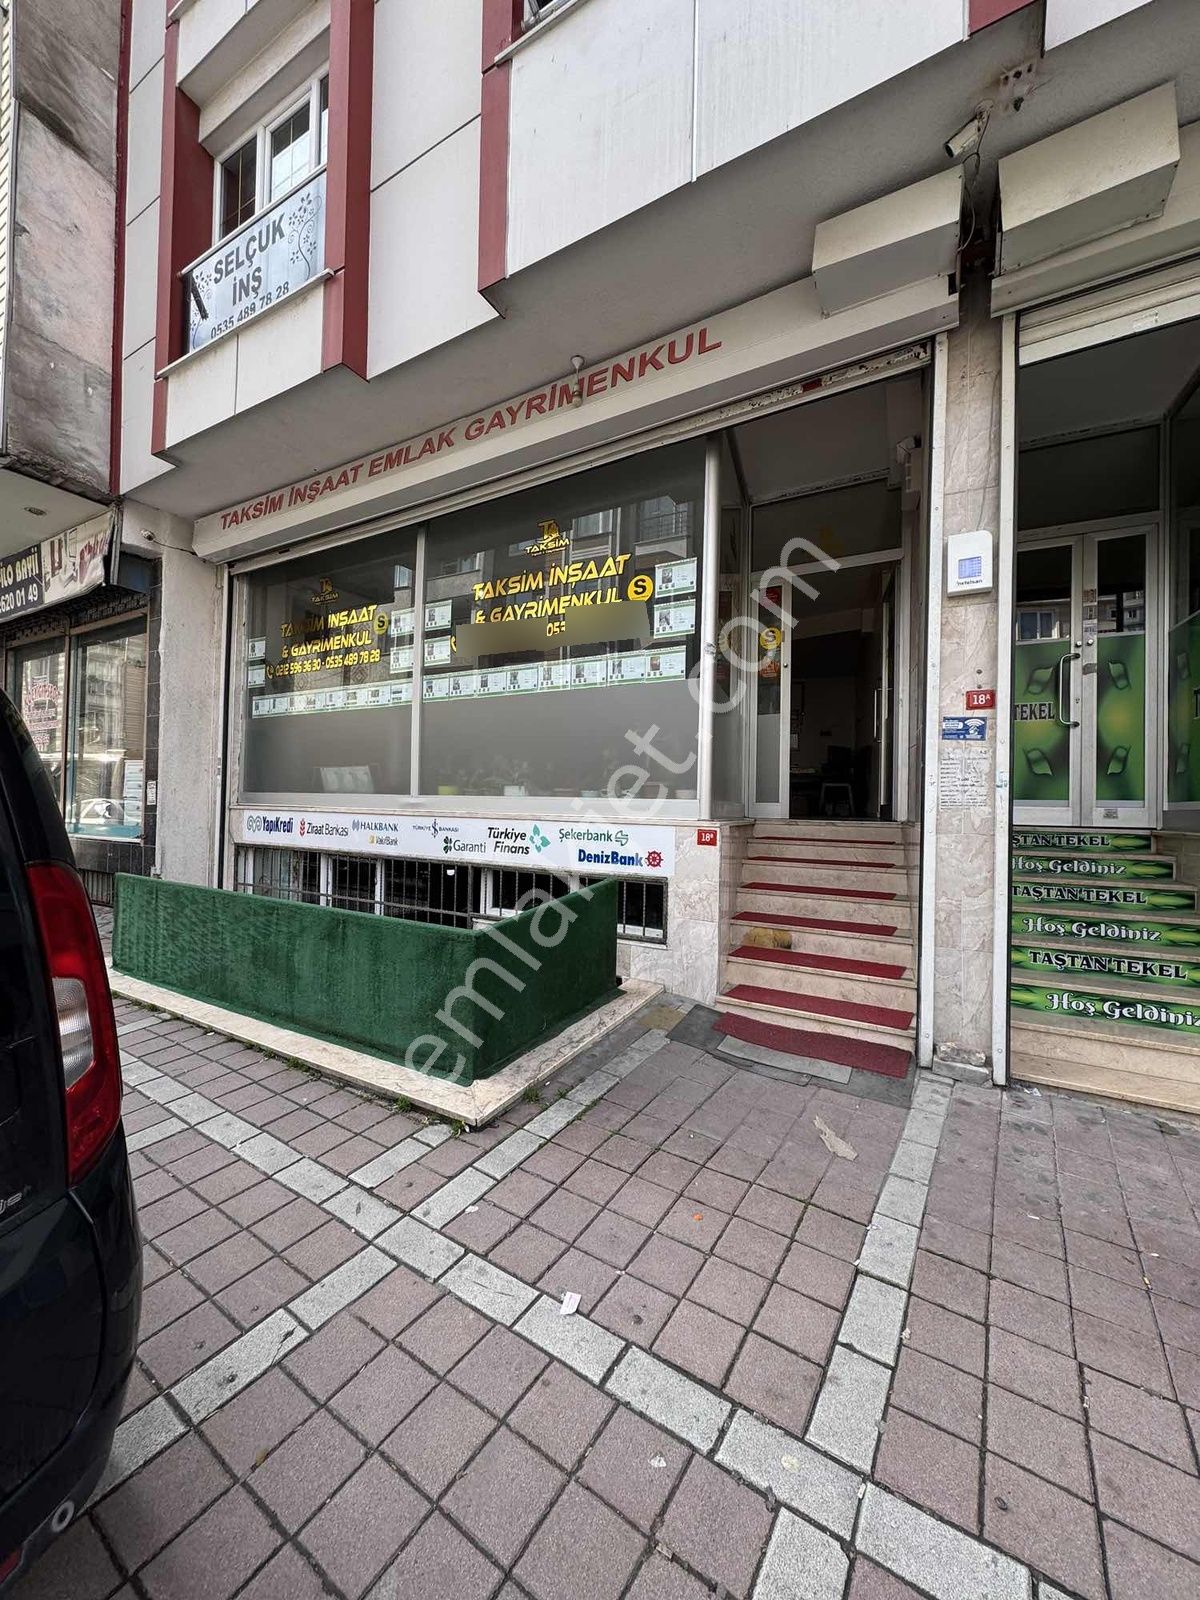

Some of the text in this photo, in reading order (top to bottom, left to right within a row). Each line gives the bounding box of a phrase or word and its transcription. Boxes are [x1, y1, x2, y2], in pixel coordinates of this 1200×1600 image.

[214, 212, 285, 285] SELÇUK
[232, 266, 262, 306] İNŞ
[210, 281, 289, 340] 0535 489 78 28
[220, 326, 723, 530] TAKSİM İNŞAAT EMLAK GAYRİMENKUL
[524, 537, 570, 554] TAKSİM
[0, 562, 14, 589] İLO
[471, 553, 632, 601] TAKSİM İNŞAAT
[0, 584, 39, 614] 620 01 49
[474, 587, 623, 624] & GAYRİMENKUL
[327, 605, 378, 630] İNŞAAT
[291, 630, 373, 656] GAYRİMENKUL
[1014, 702, 1056, 721] TEKEL
[306, 822, 324, 835] Ziraat
[360, 821, 399, 832] HALKBANK
[487, 826, 527, 844] Türkiye
[558, 828, 613, 843] Şekerbank
[453, 839, 486, 853] Garanti
[493, 841, 530, 855] Finans
[1056, 835, 1111, 847] TEKEL
[577, 848, 643, 867] DenizBank
[1049, 859, 1126, 874] Geldiniz
[1012, 885, 1148, 905] TAŞTAN TEKEL
[1023, 917, 1162, 942] Hoş Geldiniz
[1028, 950, 1188, 980] TAŞTAN TEKEL
[1046, 992, 1101, 1016] Hoş
